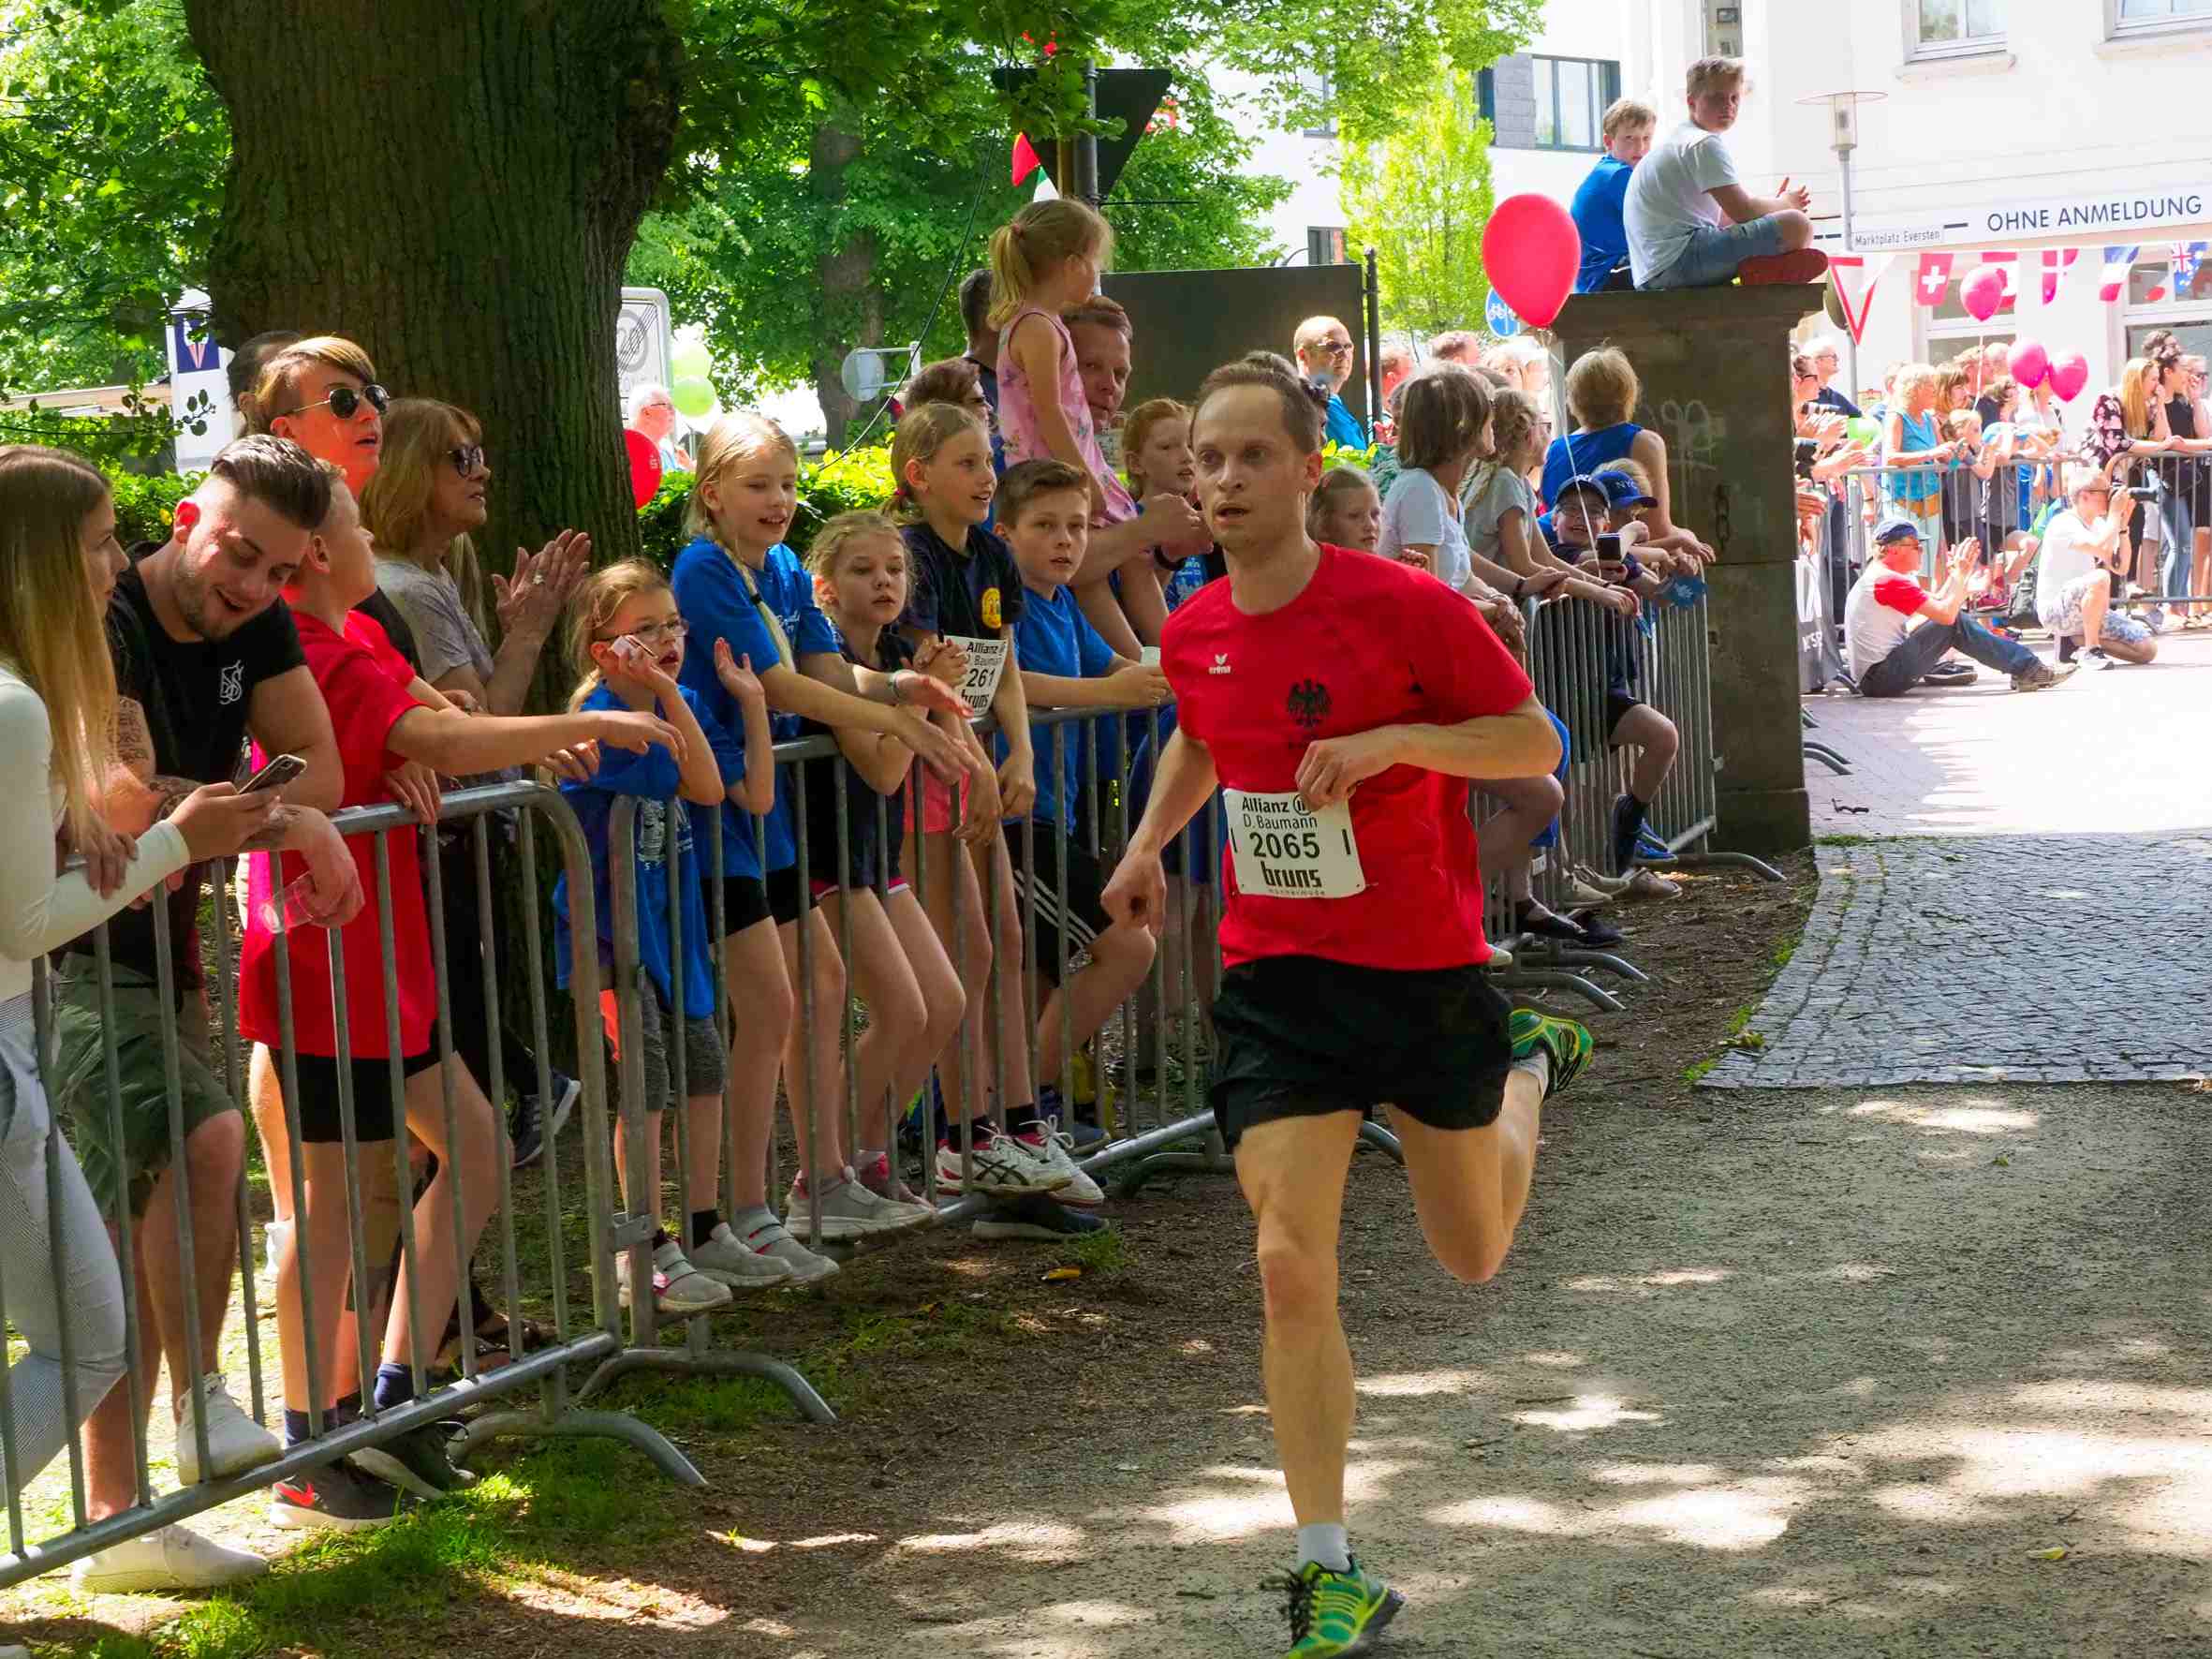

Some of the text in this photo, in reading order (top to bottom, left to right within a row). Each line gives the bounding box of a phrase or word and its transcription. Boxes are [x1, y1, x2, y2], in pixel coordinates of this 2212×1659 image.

[1987, 195, 2202, 231] OHNE ANMELDUNG
[1855, 229, 1940, 246] Marktplatz Eversten
[966, 642, 998, 654] Allianz
[1242, 796, 1290, 813] Allianz
[1243, 813, 1318, 830] D. Baumann
[1249, 832, 1320, 858] 2065
[1260, 861, 1322, 887] bruns
